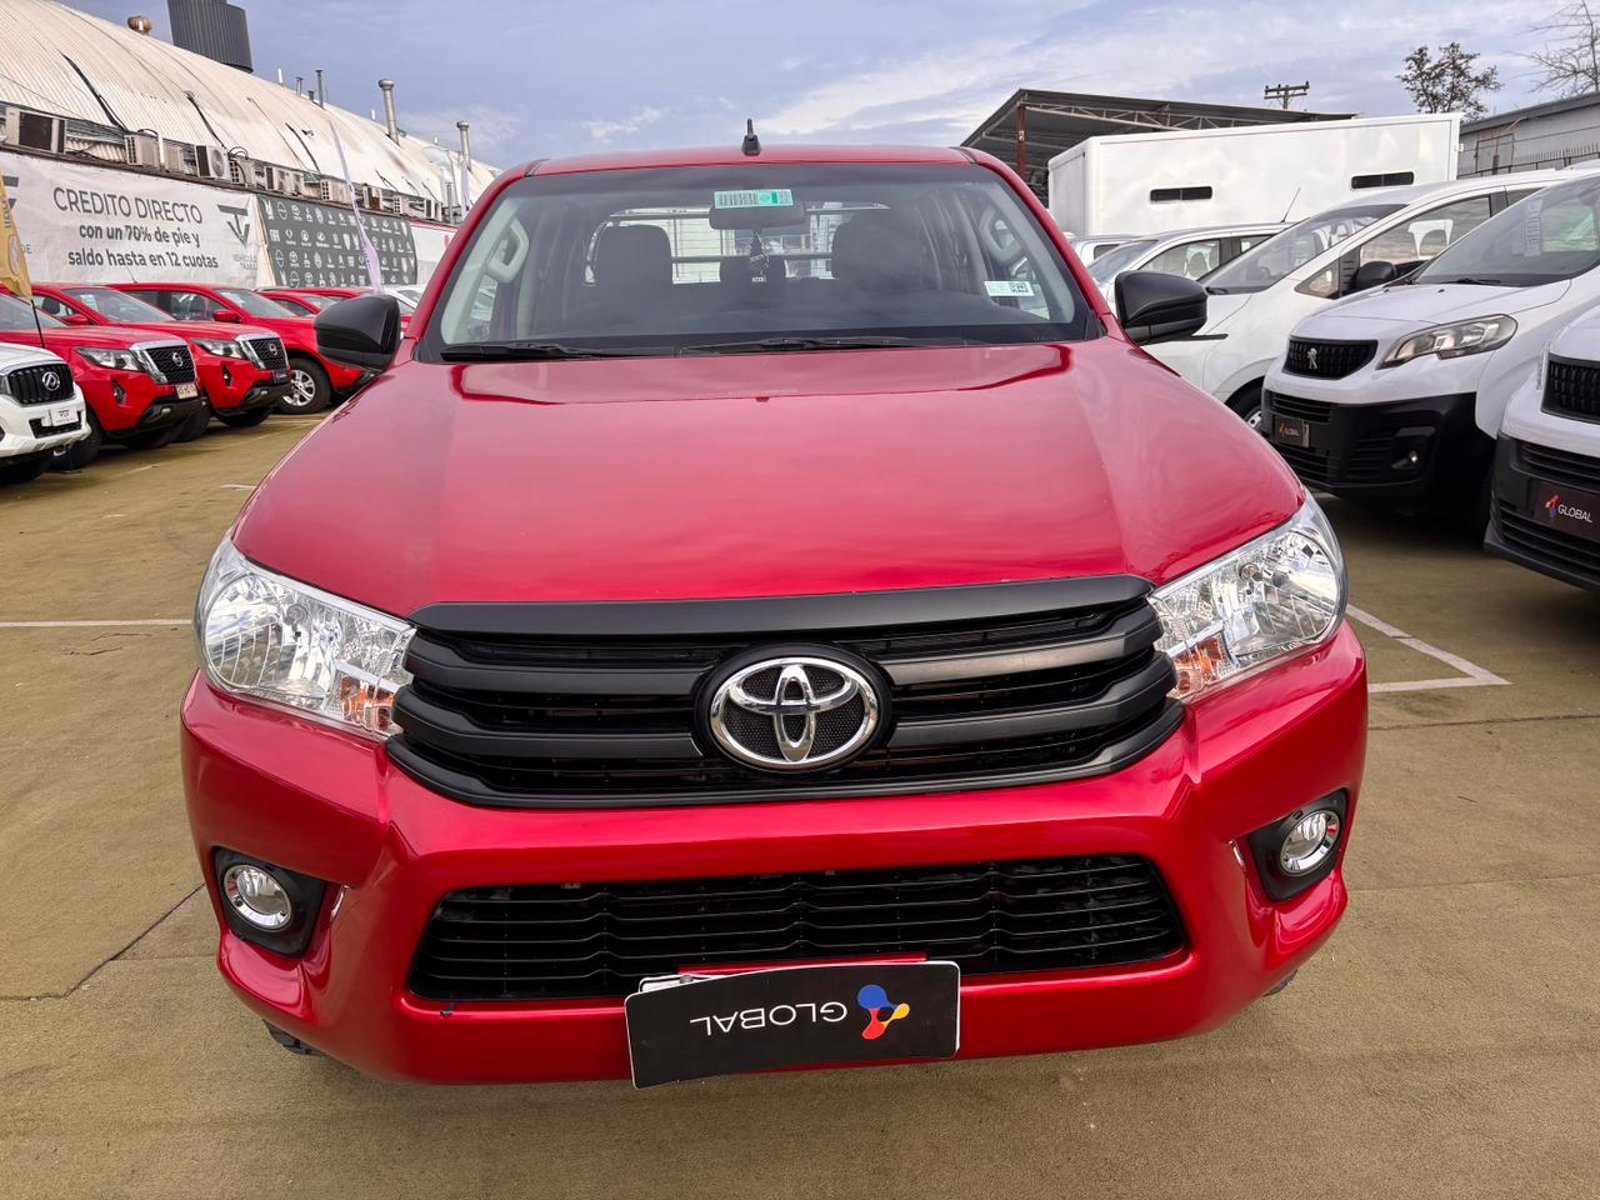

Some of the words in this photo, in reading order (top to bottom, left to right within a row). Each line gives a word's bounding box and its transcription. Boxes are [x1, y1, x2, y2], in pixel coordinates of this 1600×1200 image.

[53, 187, 132, 217] CREDITO
[134, 197, 203, 224] DIRECTO
[79, 224, 103, 239] con
[106, 225, 123, 240] un
[124, 225, 151, 242] 70%
[154, 226, 170, 243] de
[171, 227, 191, 247] pie
[192, 232, 200, 248] y
[68, 248, 104, 266] saldo
[106, 248, 147, 267] hasta
[149, 254, 166, 267] en
[165, 251, 181, 267] 12
[182, 255, 219, 269] cuotas
[1558, 504, 1593, 523] GLOBAL
[690, 1001, 848, 1036] GLOBAL
